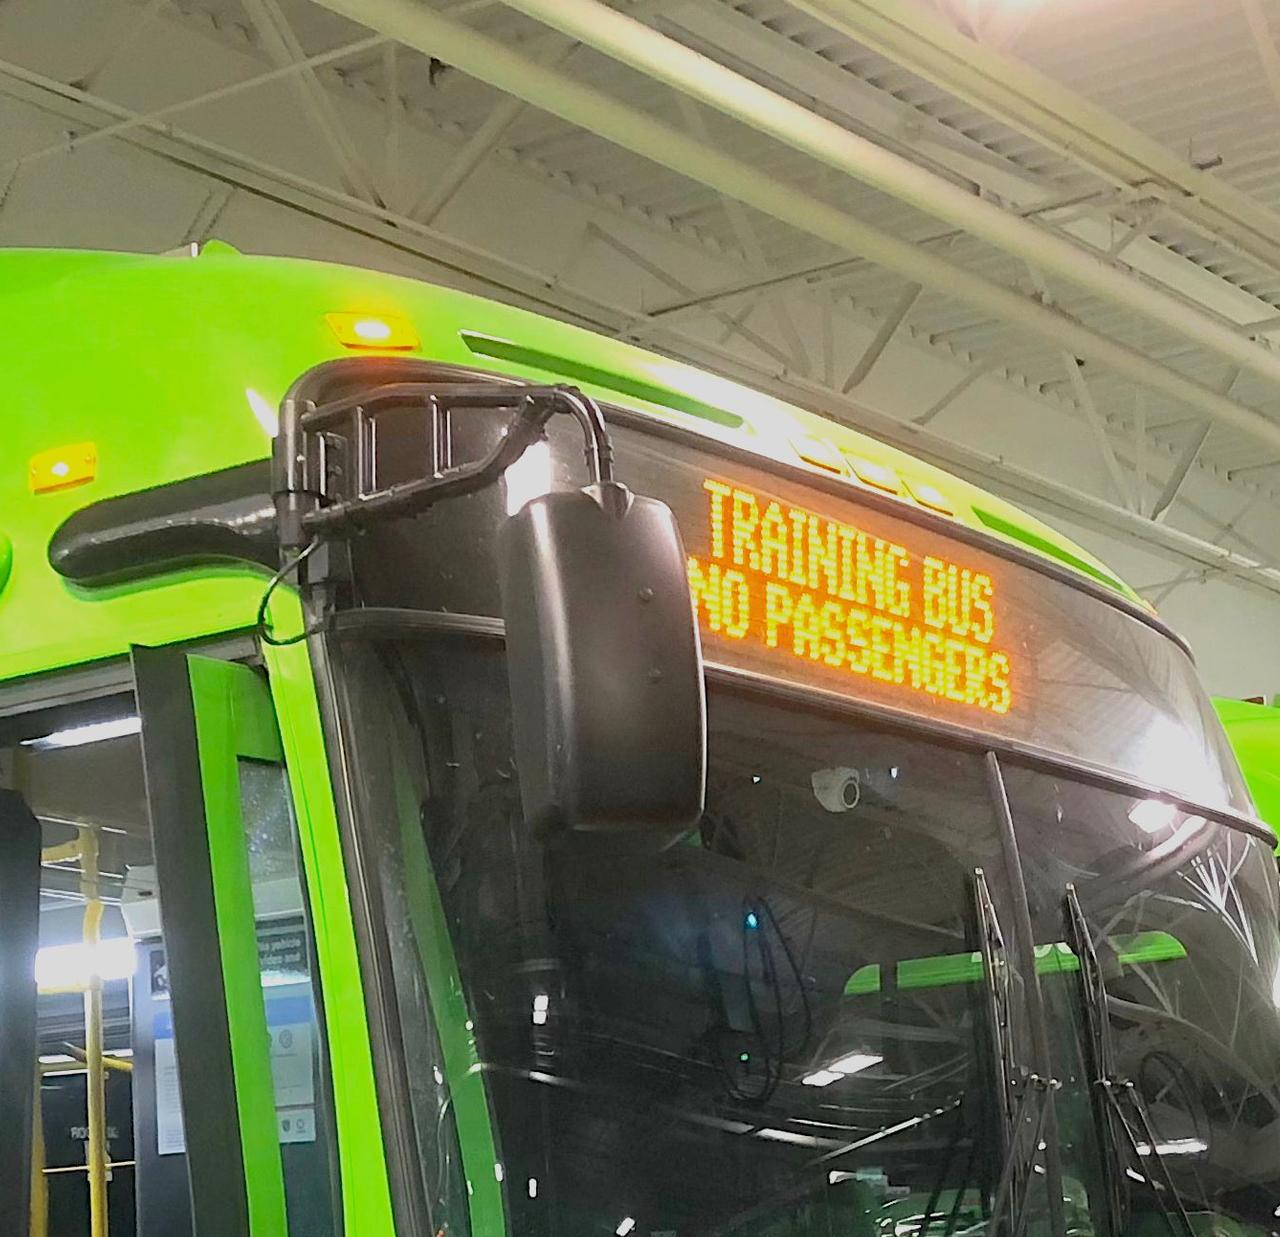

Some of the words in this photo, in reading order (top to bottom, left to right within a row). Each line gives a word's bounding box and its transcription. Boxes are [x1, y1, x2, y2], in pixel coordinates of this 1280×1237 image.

[687, 557, 750, 638] NO
[766, 582, 1012, 714] PASSENGERS
[703, 479, 911, 619] TRAINING
[923, 556, 995, 644] BUS
